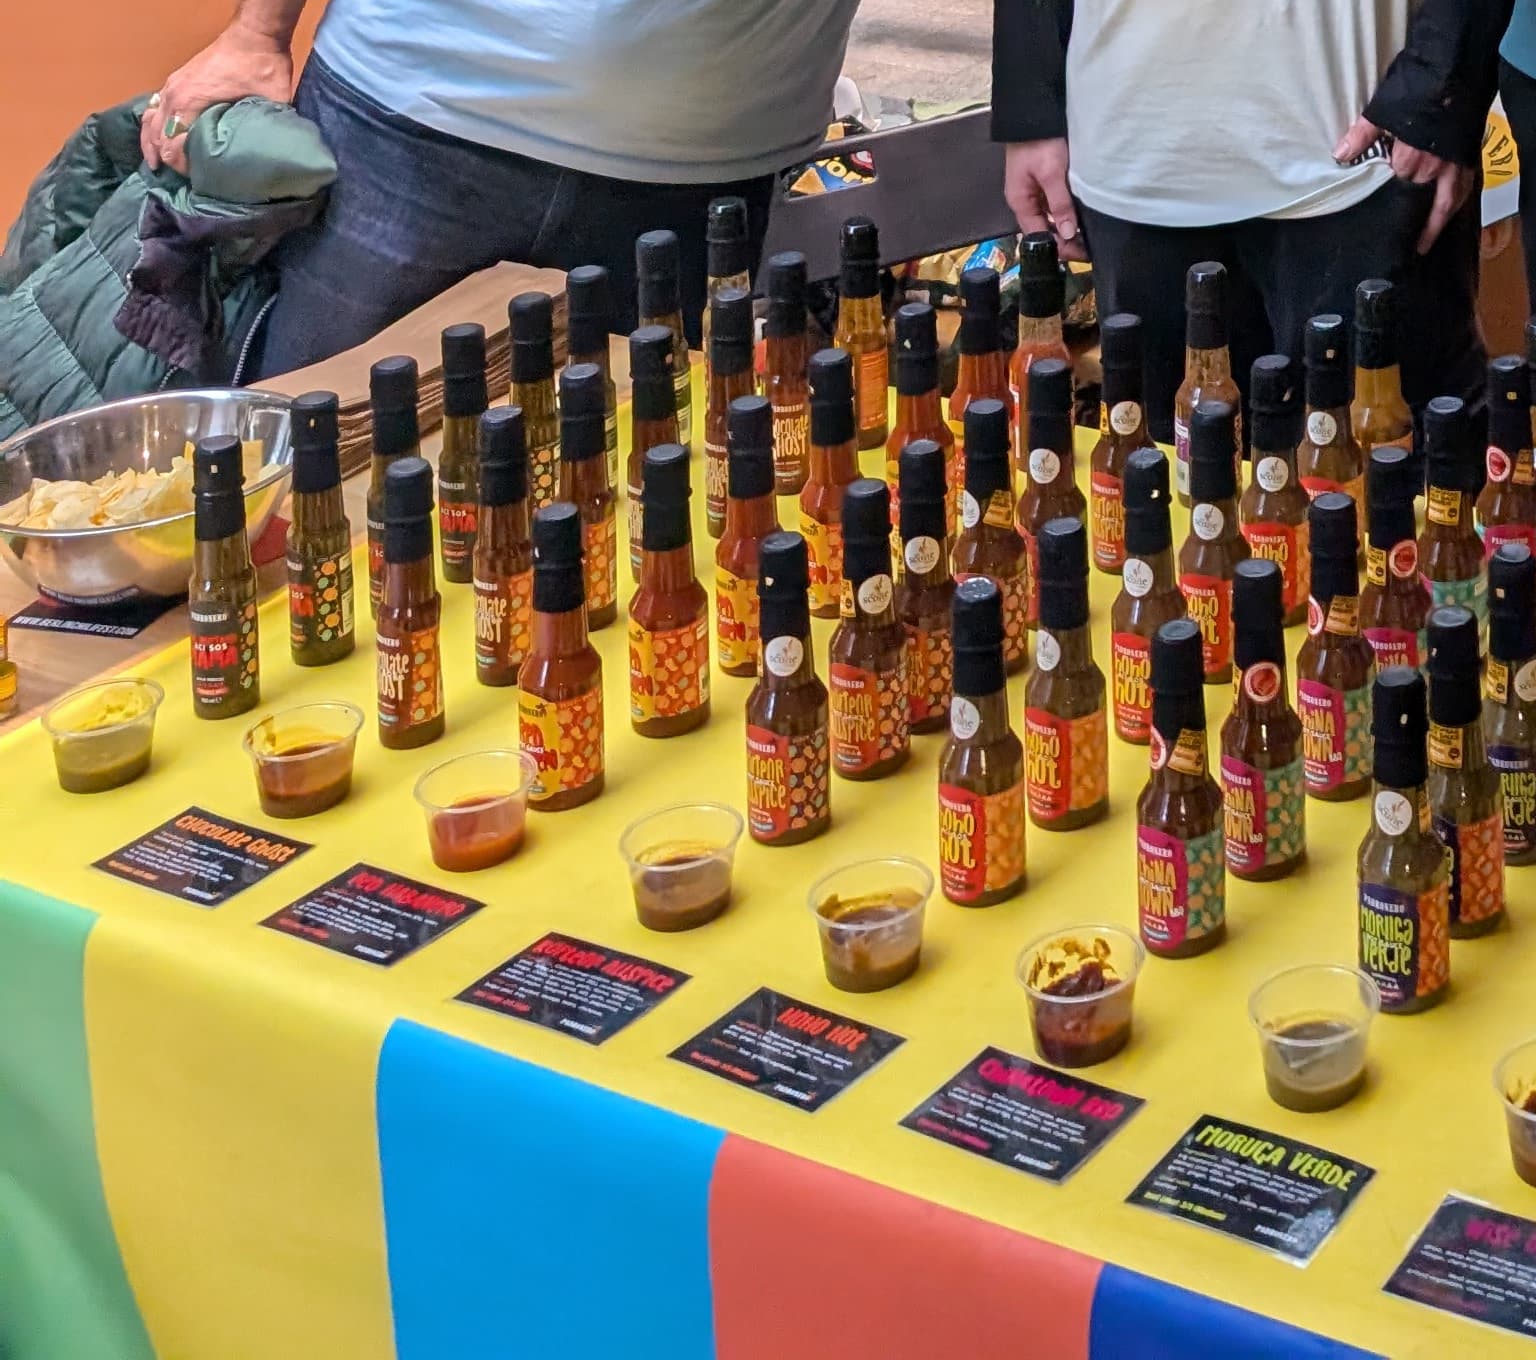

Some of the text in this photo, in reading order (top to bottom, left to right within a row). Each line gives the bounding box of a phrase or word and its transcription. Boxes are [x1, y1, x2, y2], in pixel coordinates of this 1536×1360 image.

[209, 641, 228, 653] SOS
[1195, 1124, 1287, 1167] MORUGA
[1288, 1150, 1357, 1192] VERDE
